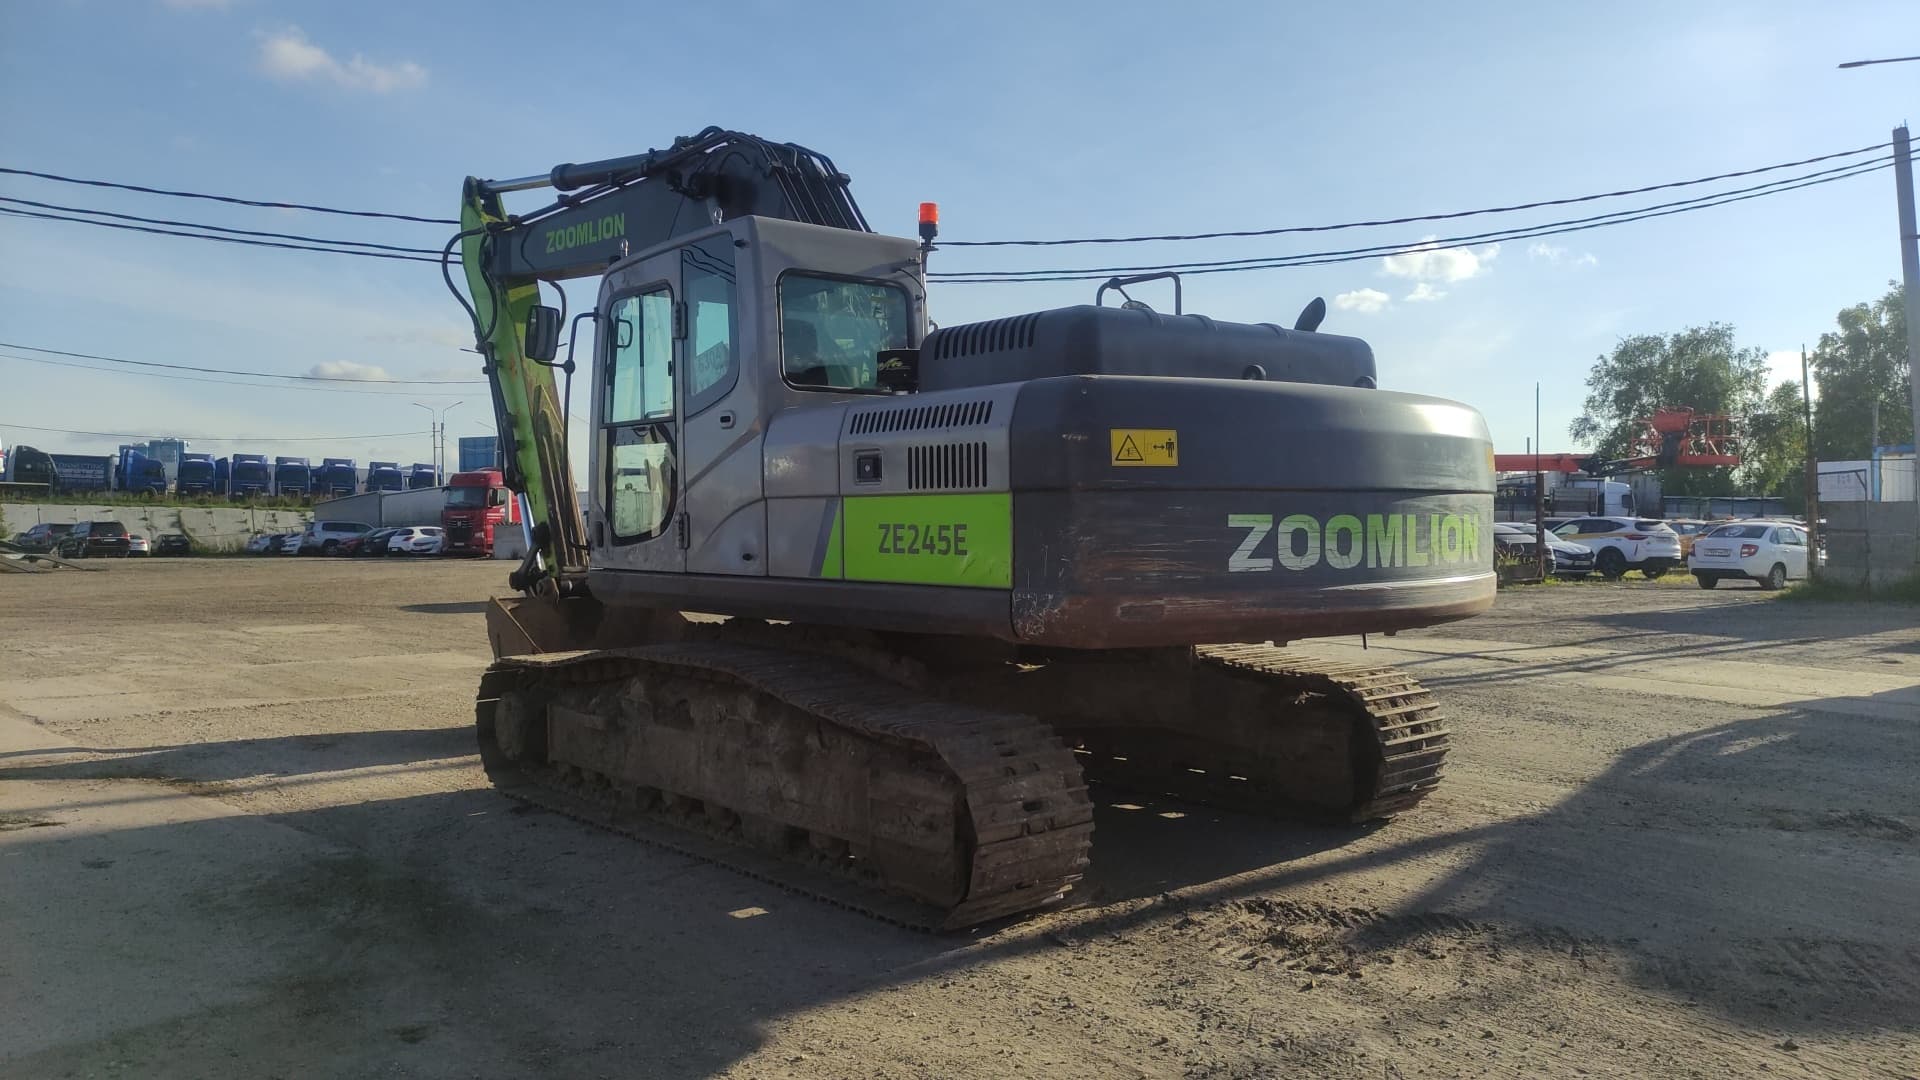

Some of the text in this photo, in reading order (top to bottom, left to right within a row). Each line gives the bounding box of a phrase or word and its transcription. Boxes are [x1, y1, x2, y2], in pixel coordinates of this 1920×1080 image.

[546, 213, 625, 254] ZOOMLION
[878, 523, 968, 555] ZE245E
[1228, 514, 1479, 572] ZOOMLION
